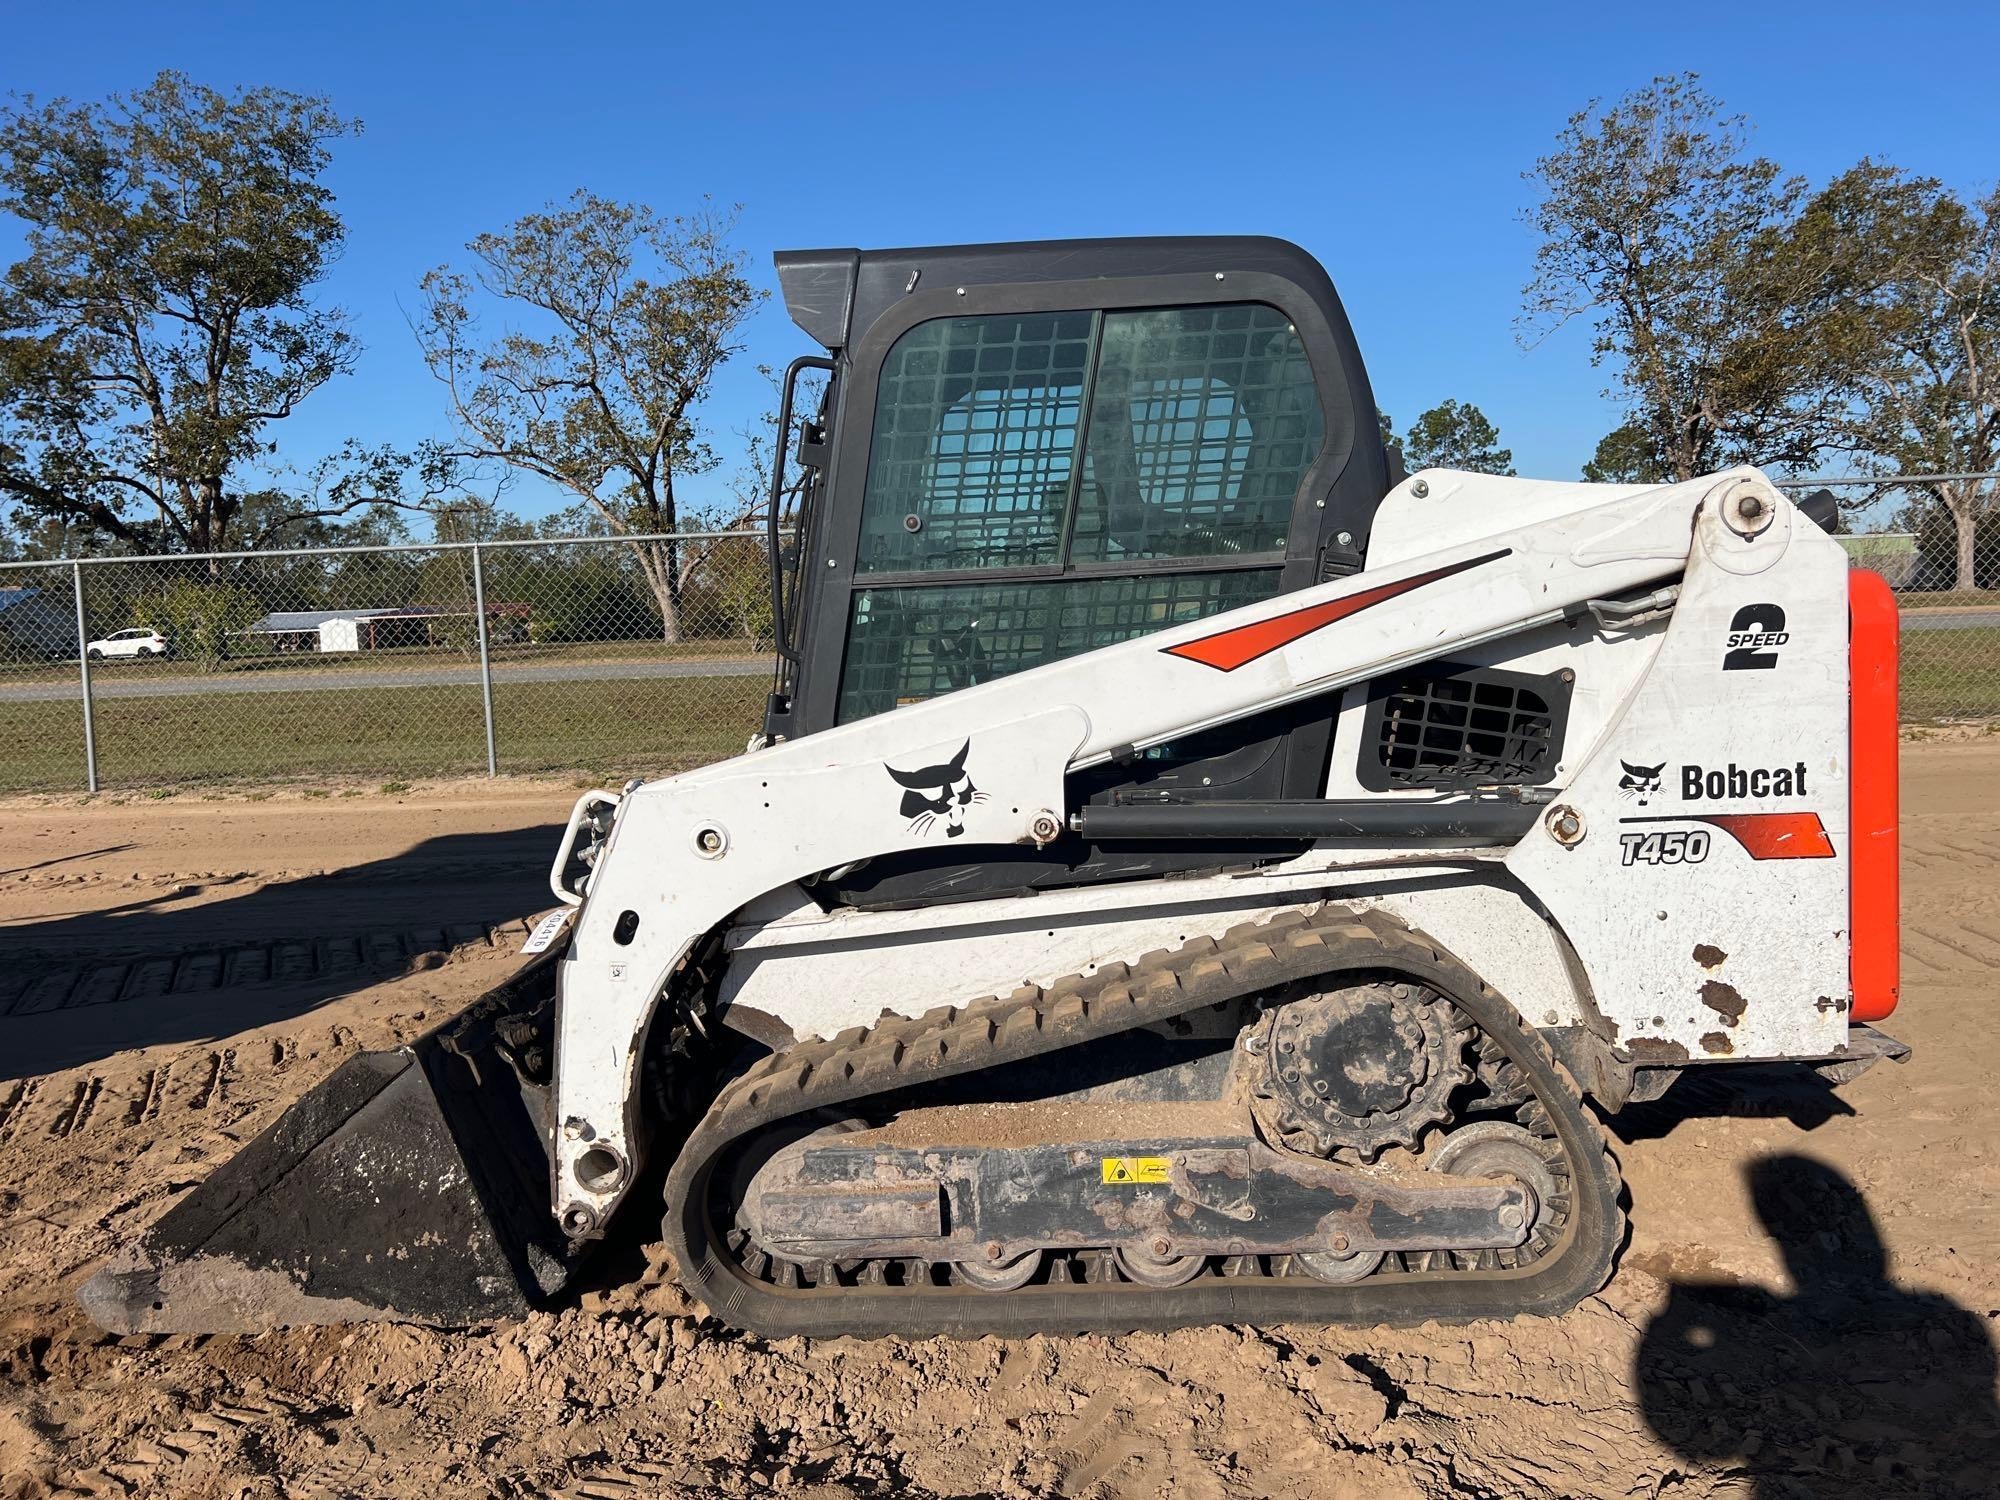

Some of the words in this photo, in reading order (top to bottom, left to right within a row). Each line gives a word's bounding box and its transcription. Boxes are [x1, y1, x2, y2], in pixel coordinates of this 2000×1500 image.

[1722, 603, 1786, 671] 2
[1726, 632, 1789, 648] SPEED
[1681, 762, 1807, 801] Bobcat
[1620, 830, 1710, 866] T450
